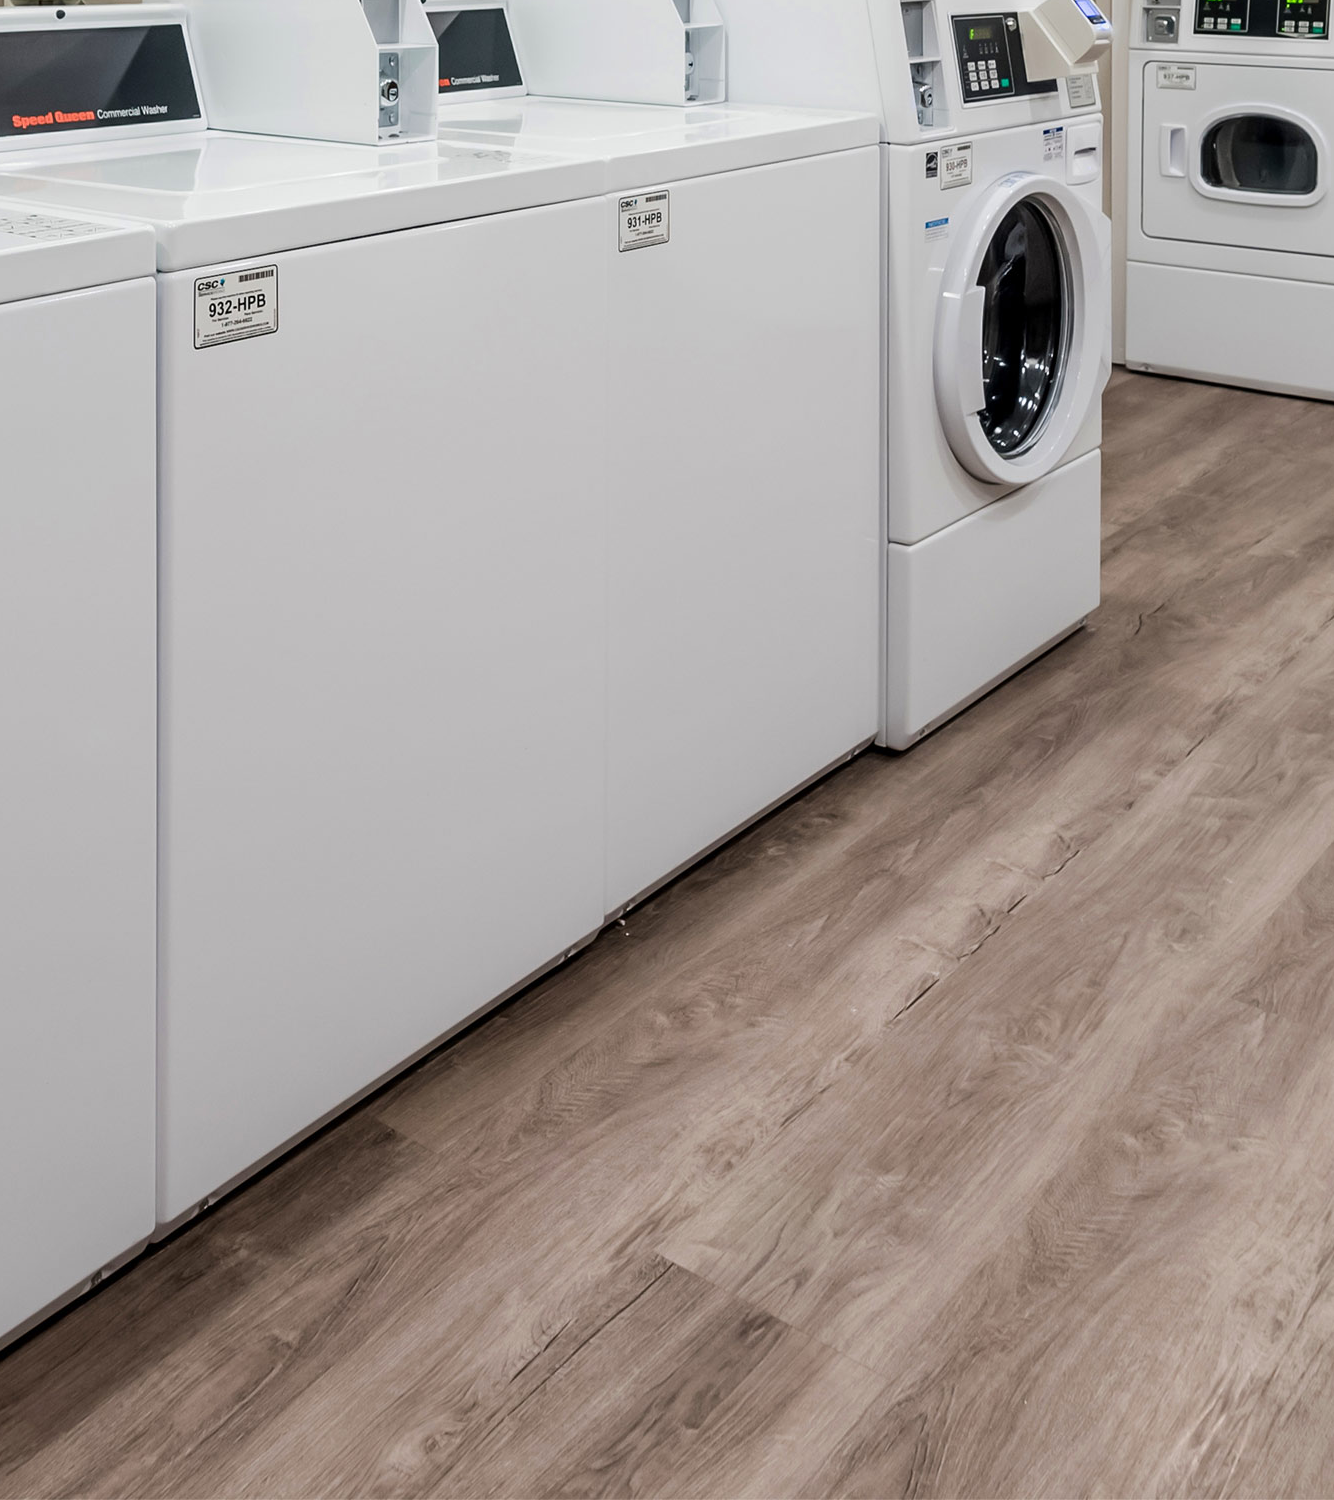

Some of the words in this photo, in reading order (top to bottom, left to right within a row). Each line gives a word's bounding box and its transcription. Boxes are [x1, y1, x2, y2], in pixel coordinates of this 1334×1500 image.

[12, 111, 53, 129] Speed
[55, 110, 95, 124] Queen
[97, 106, 141, 120] Commercial
[141, 104, 168, 115] Washer
[627, 212, 662, 229] 931-HPB
[197, 280, 219, 291] CSC
[209, 293, 266, 318] 932-HPB
